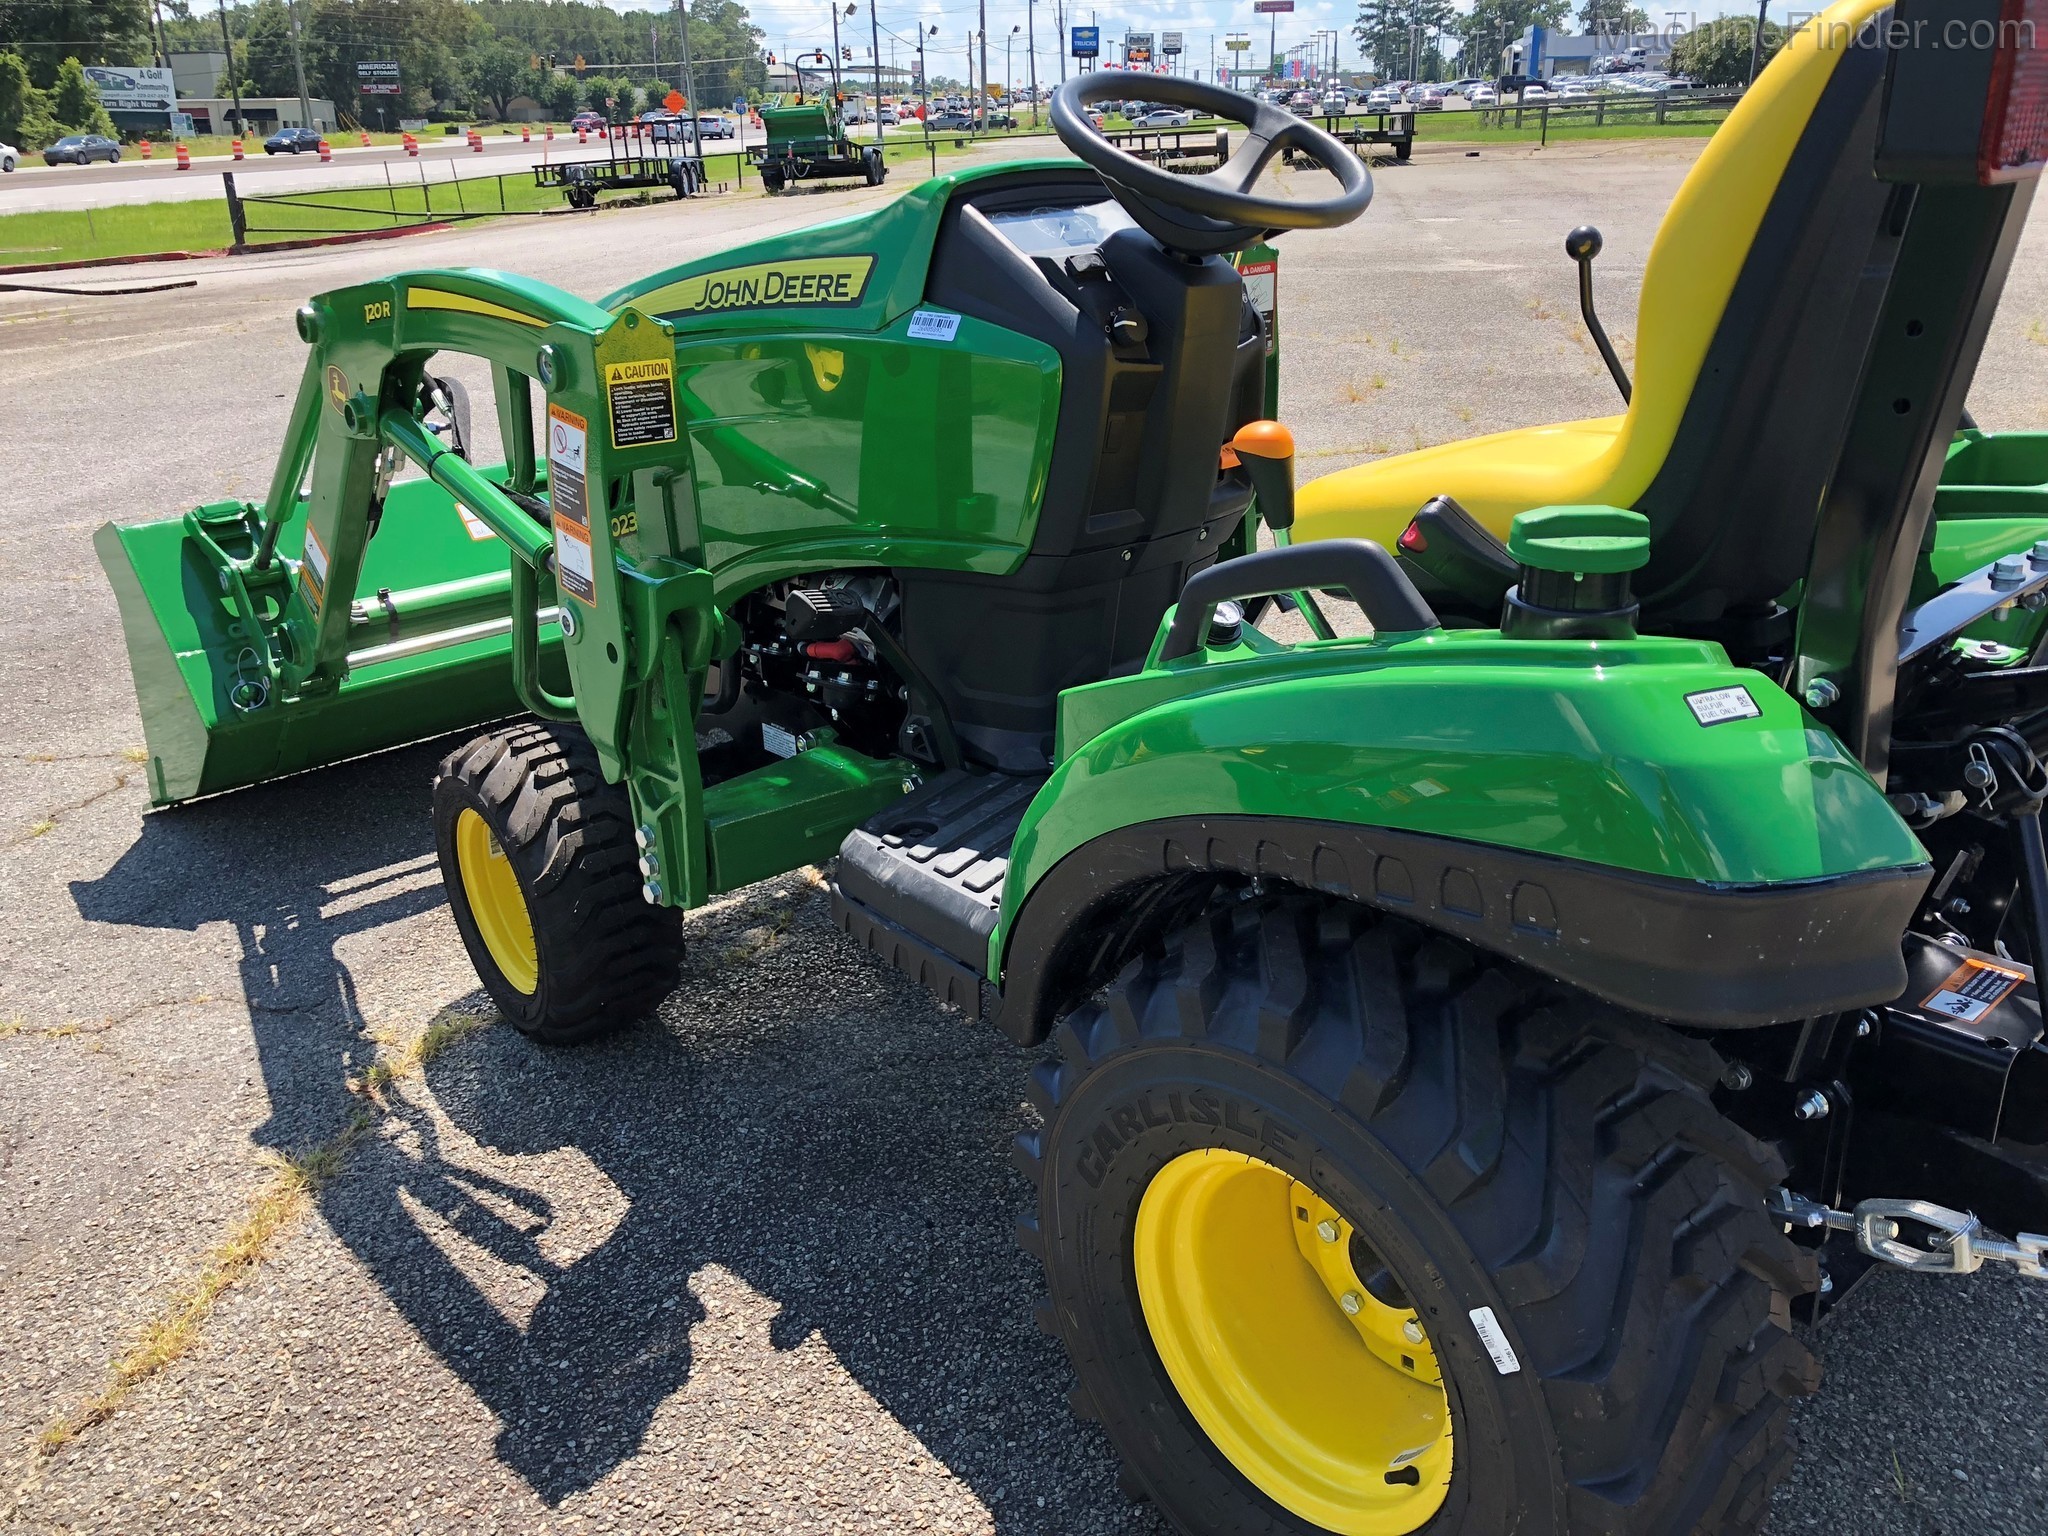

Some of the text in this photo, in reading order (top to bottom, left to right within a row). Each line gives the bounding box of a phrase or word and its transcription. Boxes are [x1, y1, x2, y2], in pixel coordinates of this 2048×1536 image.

[139, 69, 163, 80] A Golf
[135, 82, 169, 93] Community
[100, 99, 159, 109] Turn Right Now
[1249, 264, 1272, 274] DANGER
[695, 271, 852, 308] JOHN DEERE
[624, 361, 669, 380] CAUTION
[556, 409, 585, 429] WARNING
[562, 520, 589, 543] WARNING
[1692, 692, 1731, 705] ULTRA LOW
[1696, 701, 1725, 712] SULFUR
[1701, 707, 1738, 720] FUEL ONLY
[1076, 1089, 1298, 1190] CARLISLE
